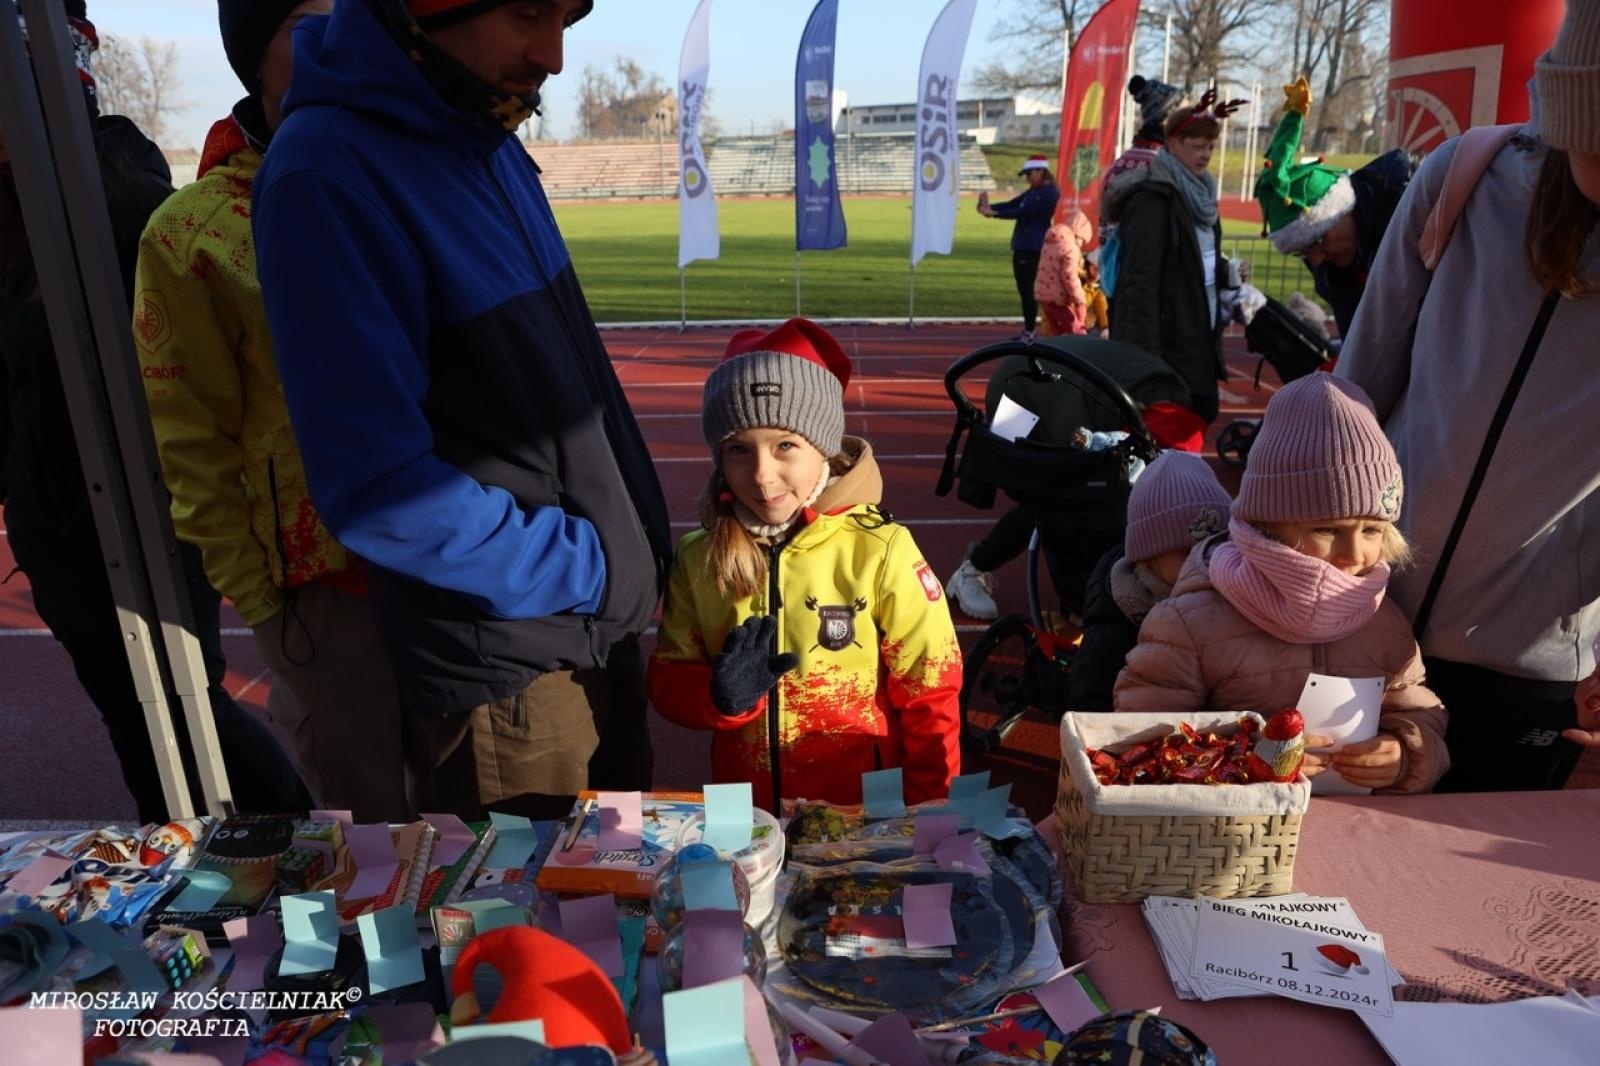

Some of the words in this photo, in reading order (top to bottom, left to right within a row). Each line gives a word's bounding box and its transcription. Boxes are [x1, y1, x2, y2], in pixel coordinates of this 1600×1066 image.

[921, 73, 948, 192] OSiR
[143, 363, 186, 379] CIBÓRZ
[593, 852, 660, 867] Scratch
[827, 905, 903, 916] LSKA
[1254, 902, 1337, 912] ŁAJKOWY
[1212, 902, 1247, 917] BIEG
[1251, 911, 1368, 942] MIKOŁAJKOWY
[1280, 951, 1299, 972] 1
[1205, 962, 1273, 985] Racibórz
[1277, 977, 1378, 1006] 08.12.2024r
